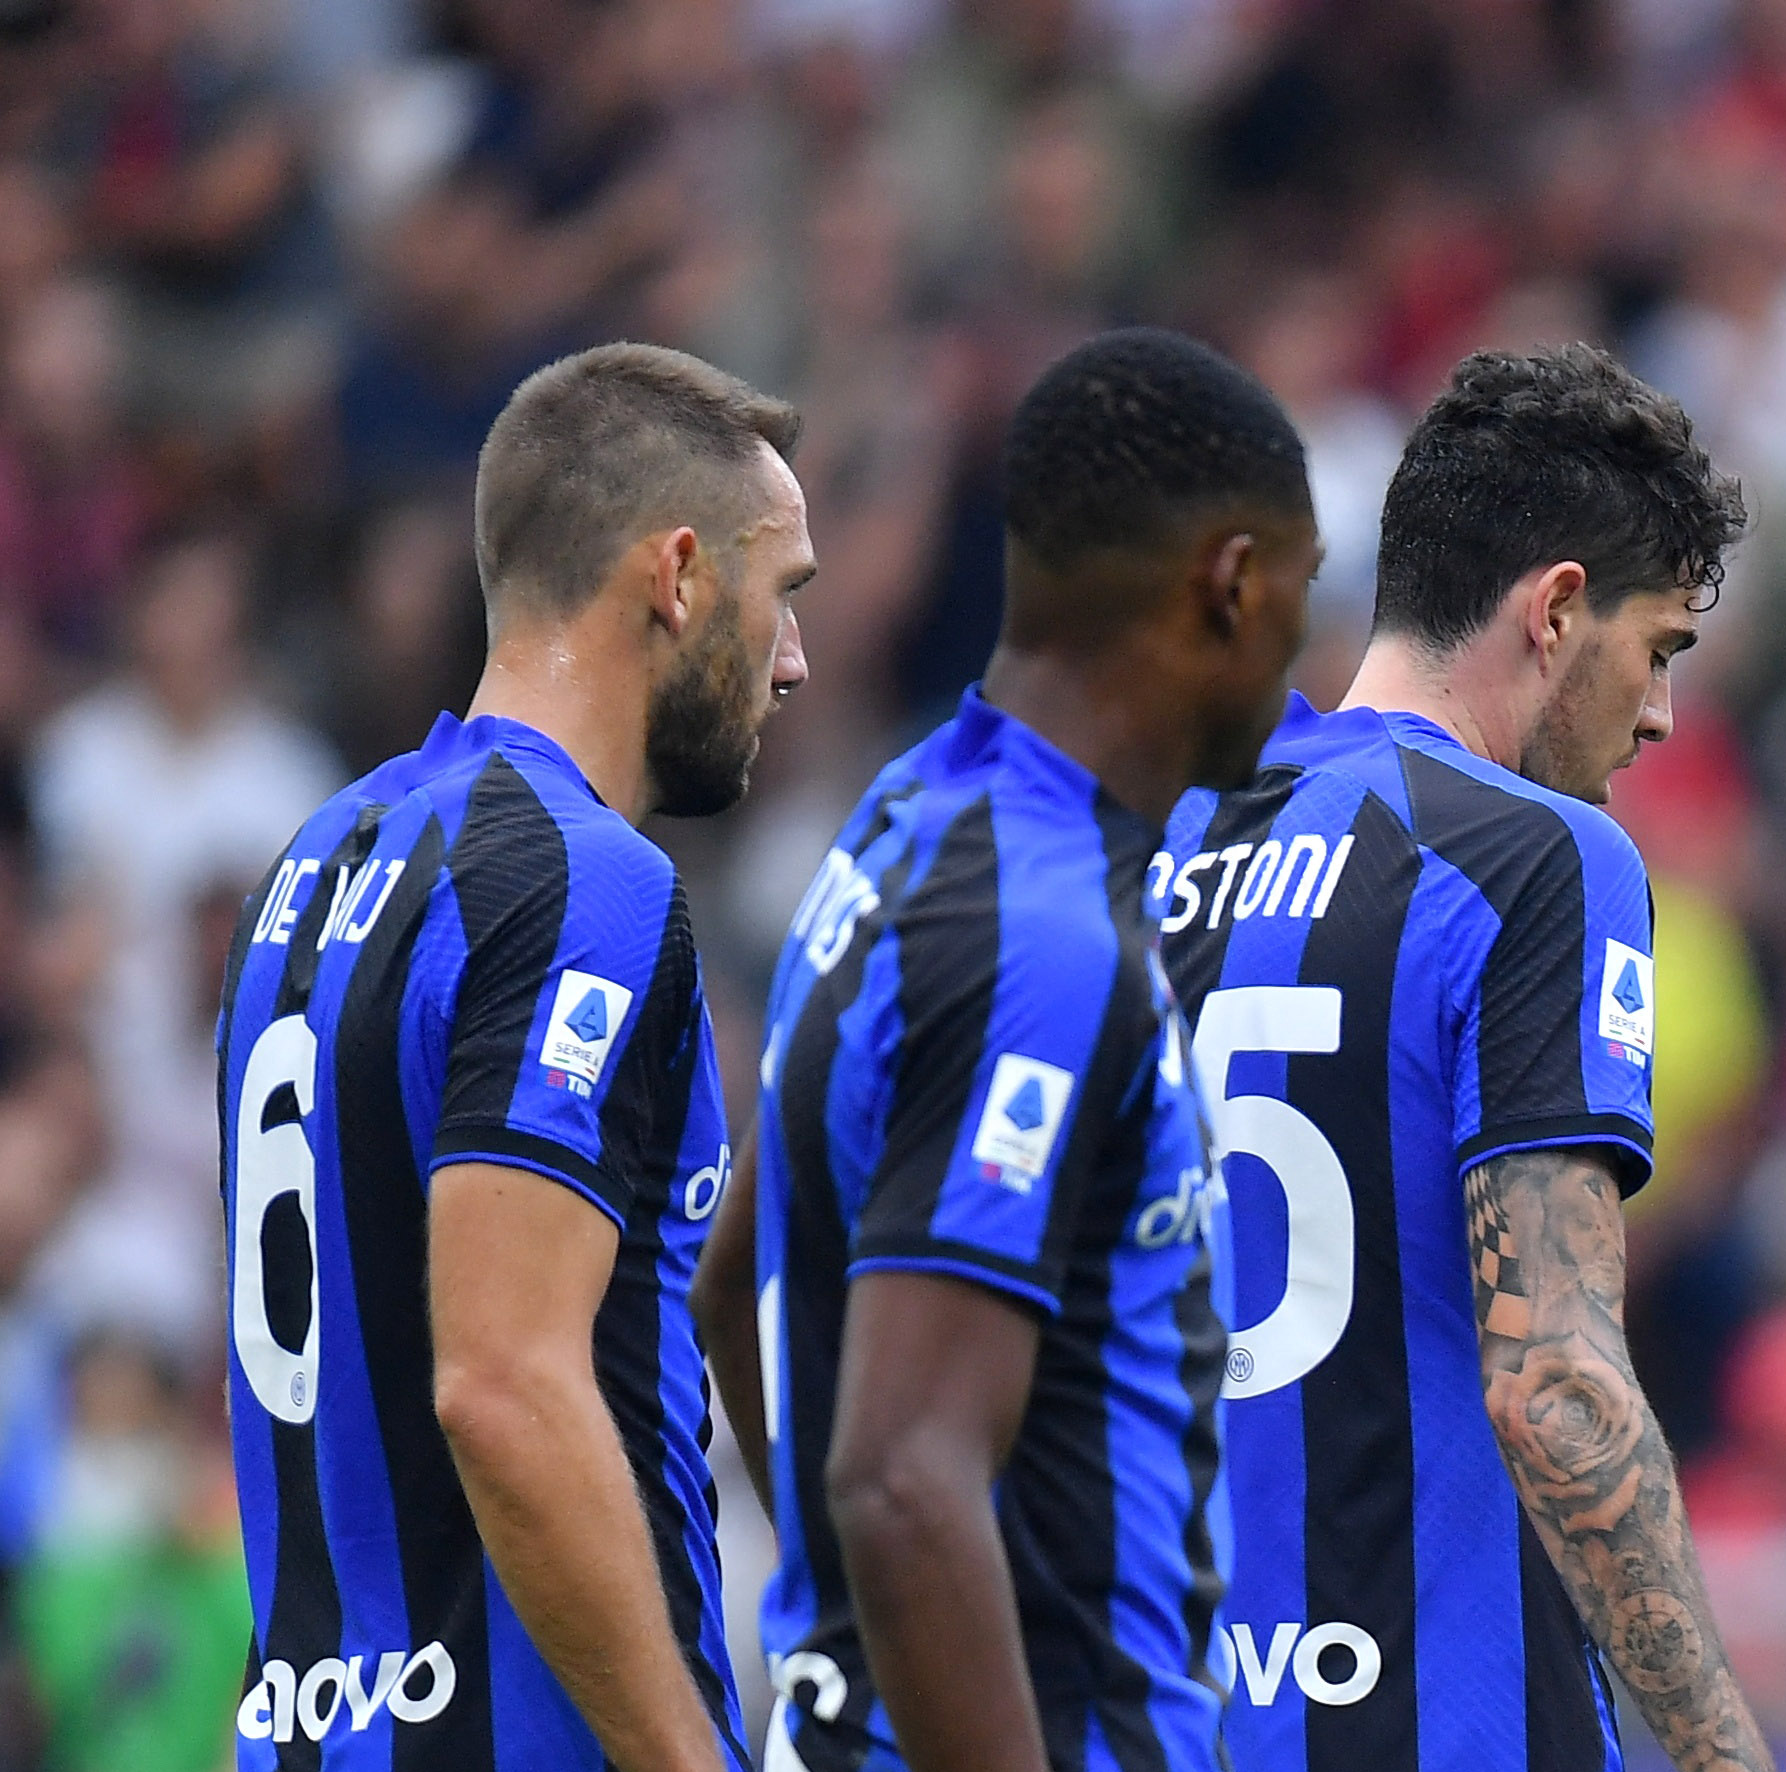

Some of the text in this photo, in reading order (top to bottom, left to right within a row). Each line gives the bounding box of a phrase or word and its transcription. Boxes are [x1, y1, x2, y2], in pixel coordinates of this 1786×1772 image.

[252, 858, 321, 944] DE
[554, 1042, 594, 1063] SERIE
[233, 1013, 318, 1424] 6
